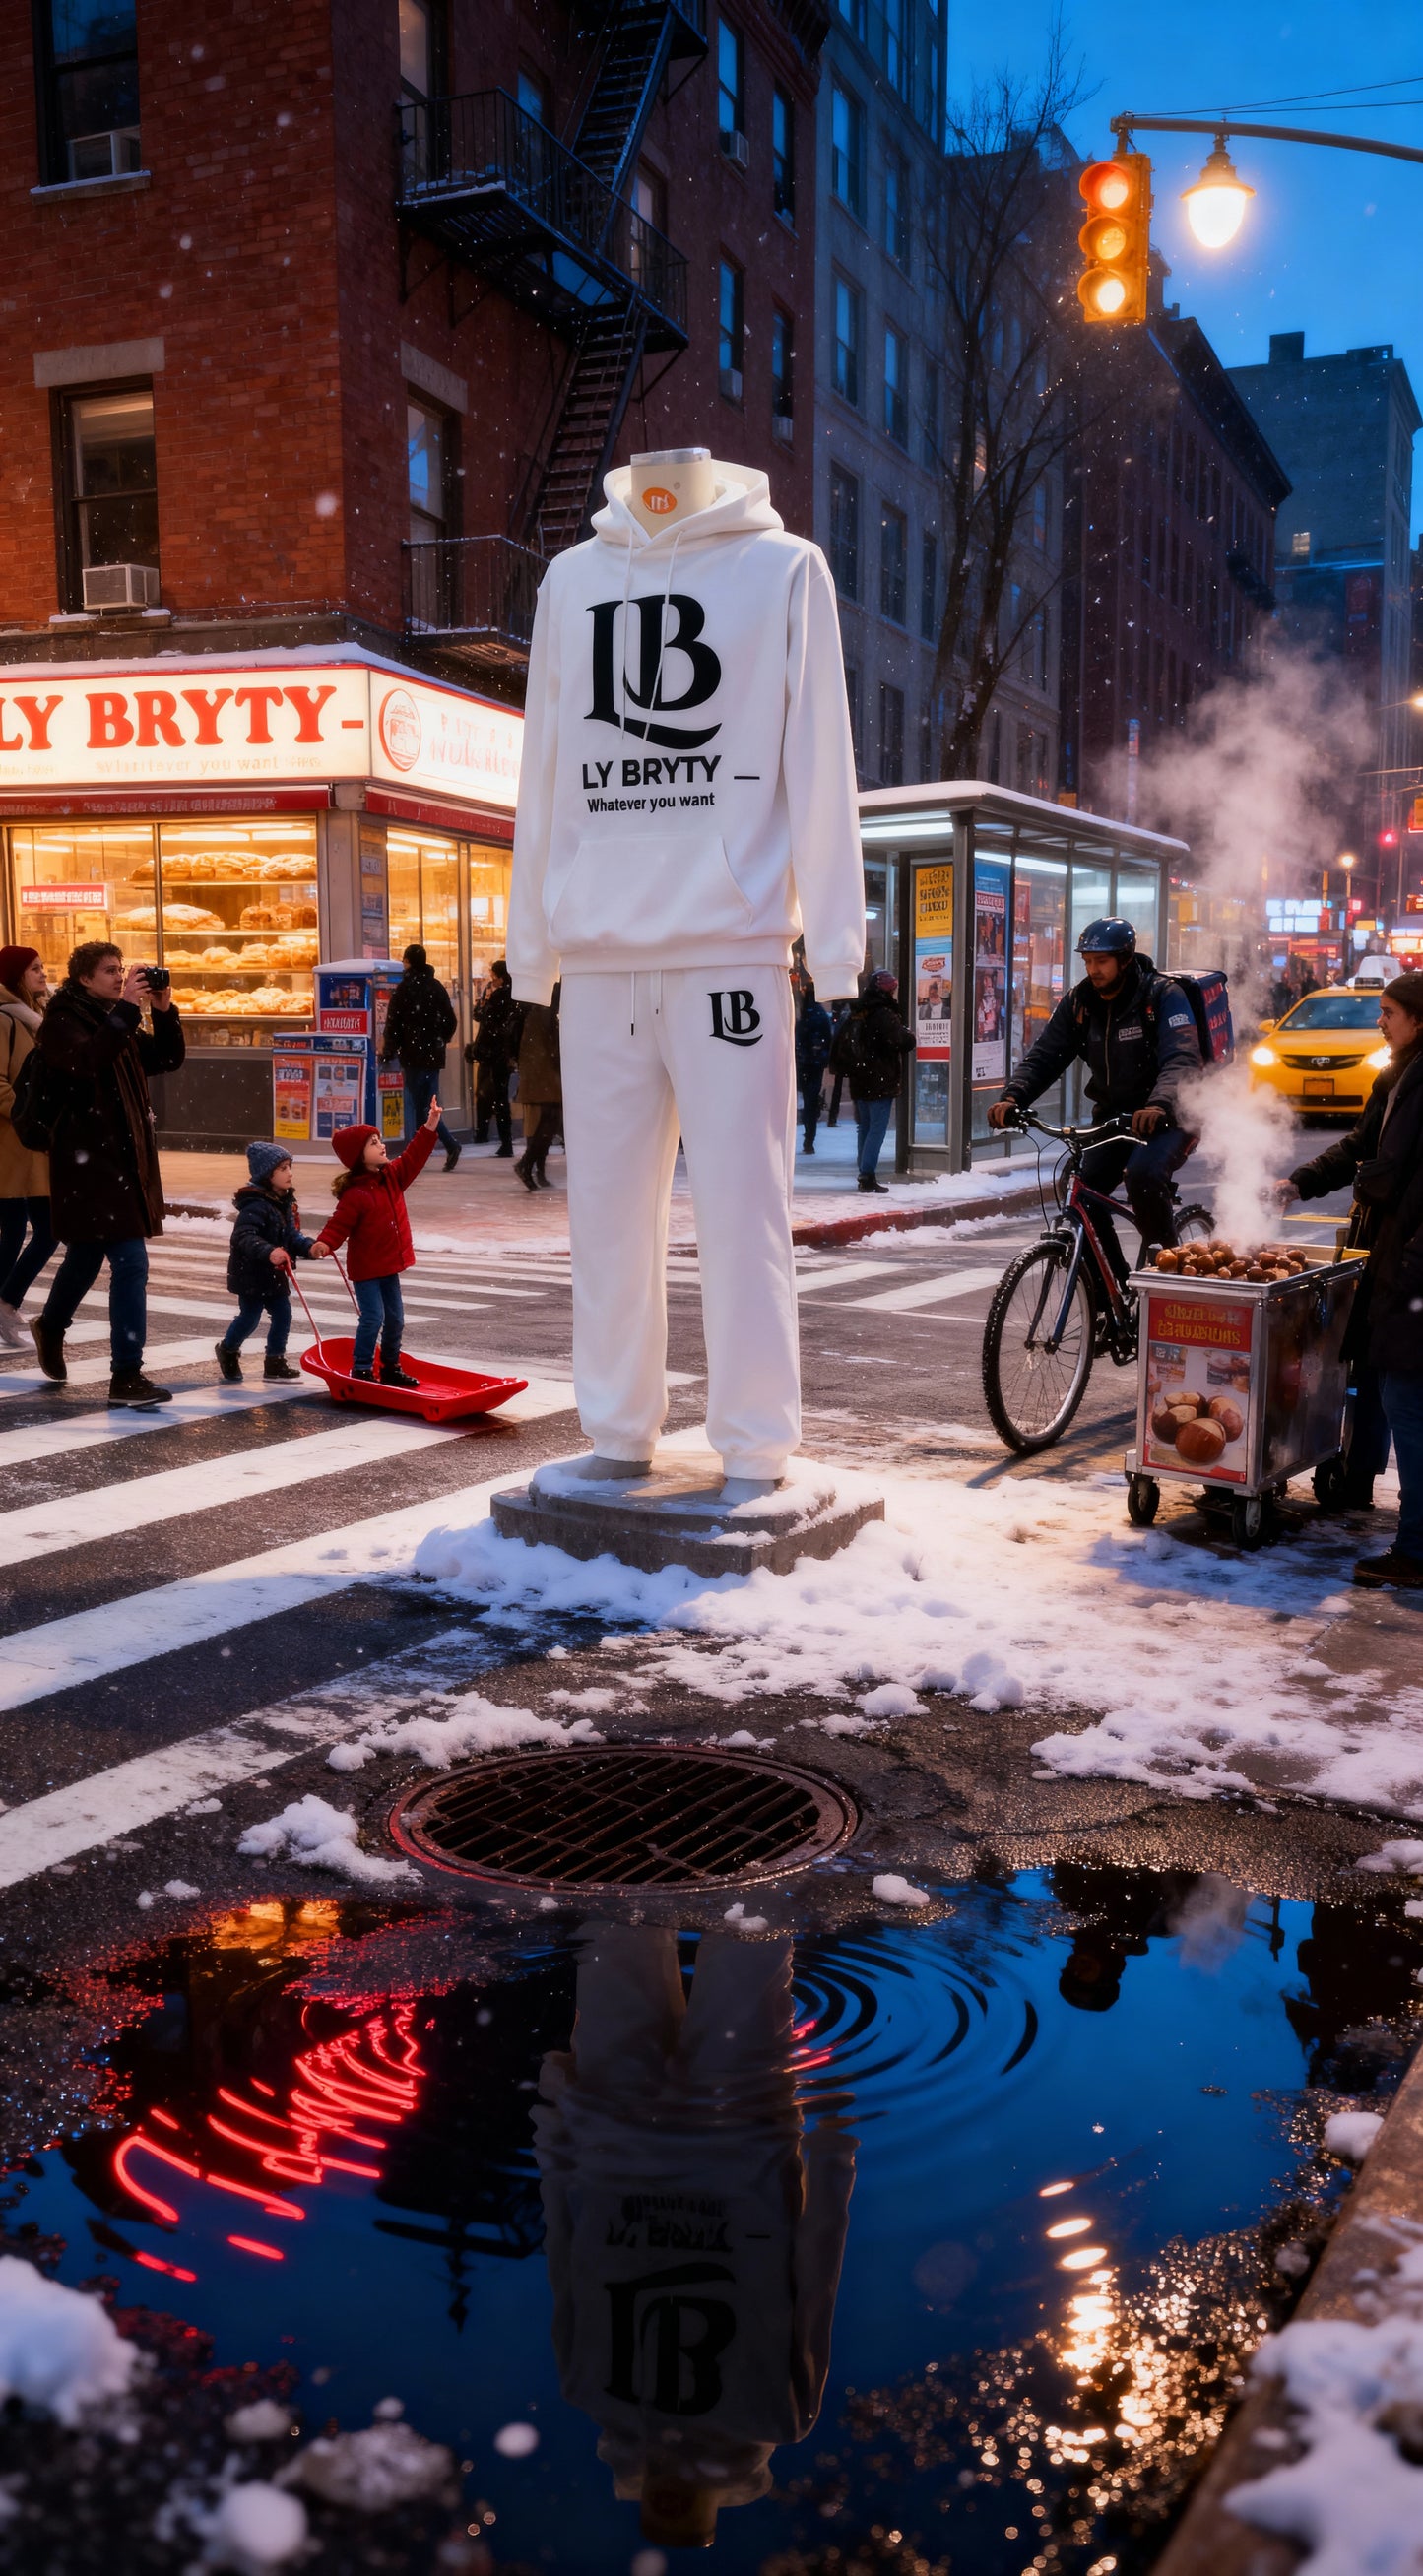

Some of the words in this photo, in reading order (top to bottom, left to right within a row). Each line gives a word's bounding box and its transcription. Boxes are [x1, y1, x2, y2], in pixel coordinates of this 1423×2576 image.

[582, 761, 614, 790] LY
[622, 754, 722, 787] BRYTY
[587, 797, 647, 813] Whatever
[650, 795, 676, 813] you
[679, 792, 716, 807] want
